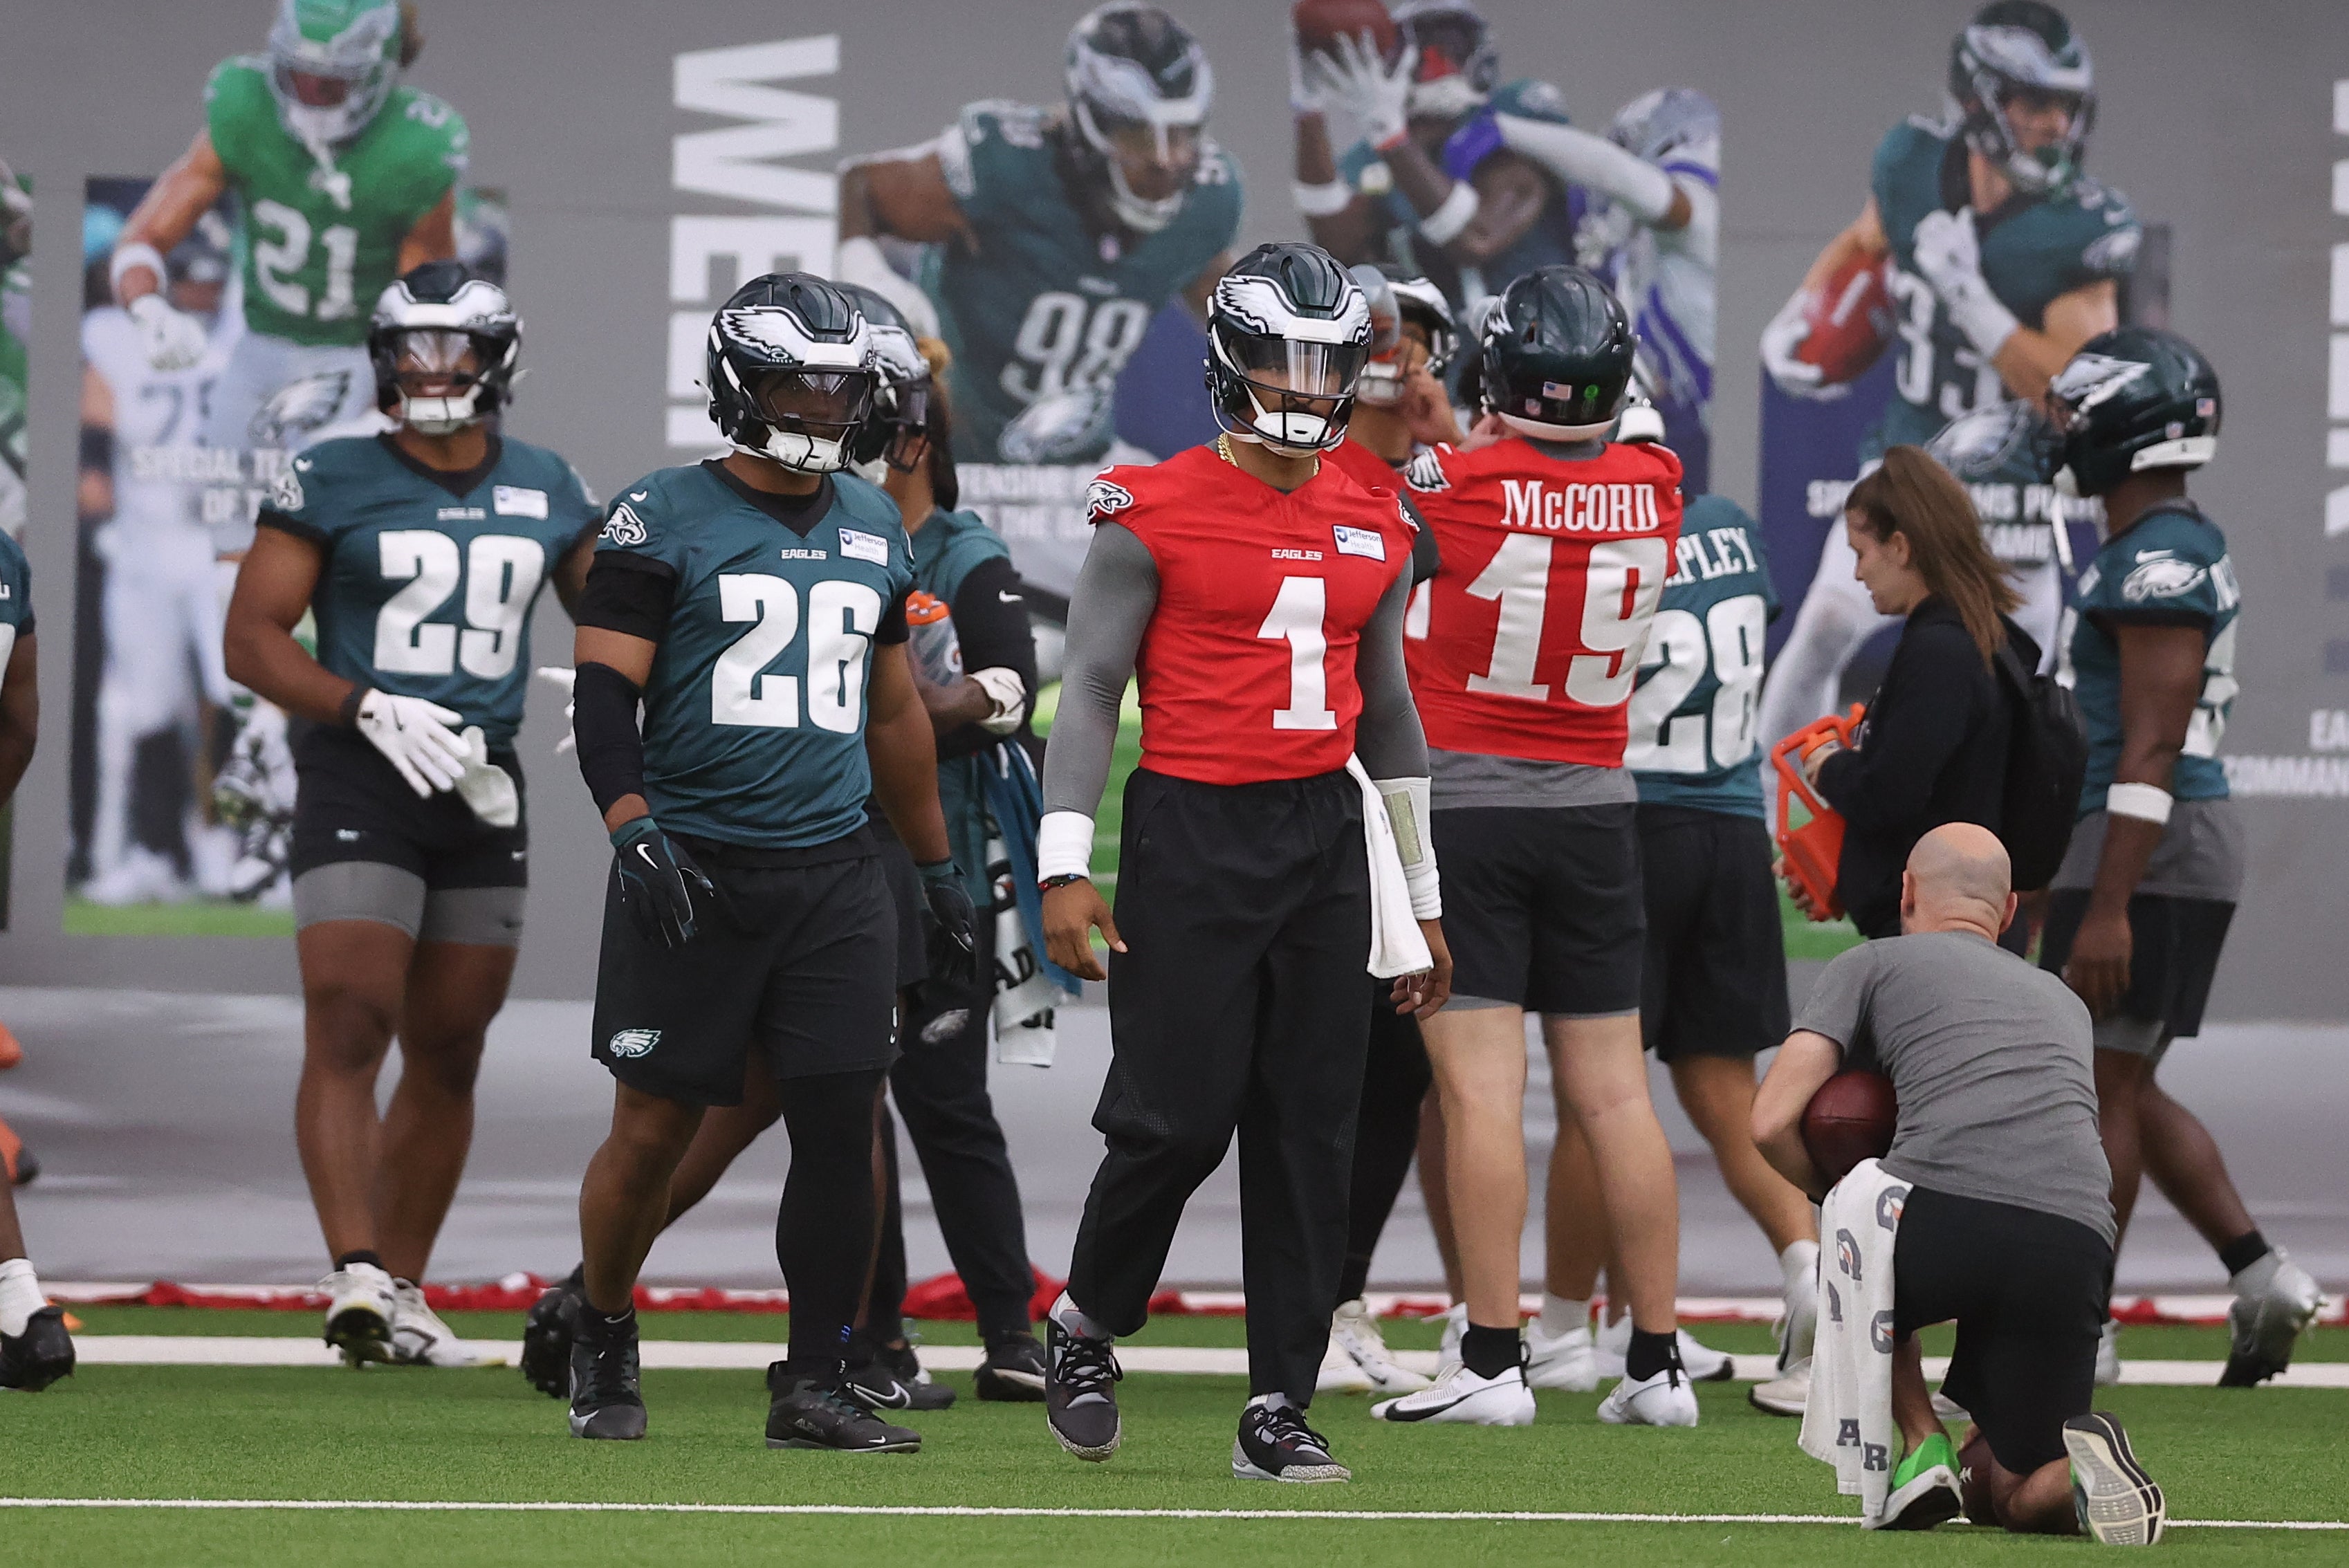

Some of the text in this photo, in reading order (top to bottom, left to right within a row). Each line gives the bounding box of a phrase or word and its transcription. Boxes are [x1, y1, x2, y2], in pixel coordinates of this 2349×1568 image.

[251, 199, 359, 317] 21
[666, 33, 840, 450] WE
[998, 290, 1151, 407] 98
[781, 548, 827, 560] EAGLES
[854, 532, 887, 548] Jefferson
[1271, 548, 1323, 562] EAGLES
[1349, 530, 1382, 543] Jefferson
[1349, 540, 1375, 552] Health
[1500, 479, 1659, 532] McCORD
[1665, 527, 1758, 587] PLEY
[374, 528, 545, 681] 29
[711, 573, 881, 735] 26
[1257, 576, 1338, 731] 1
[1465, 533, 1668, 707] 19
[1622, 593, 1768, 775] 28
